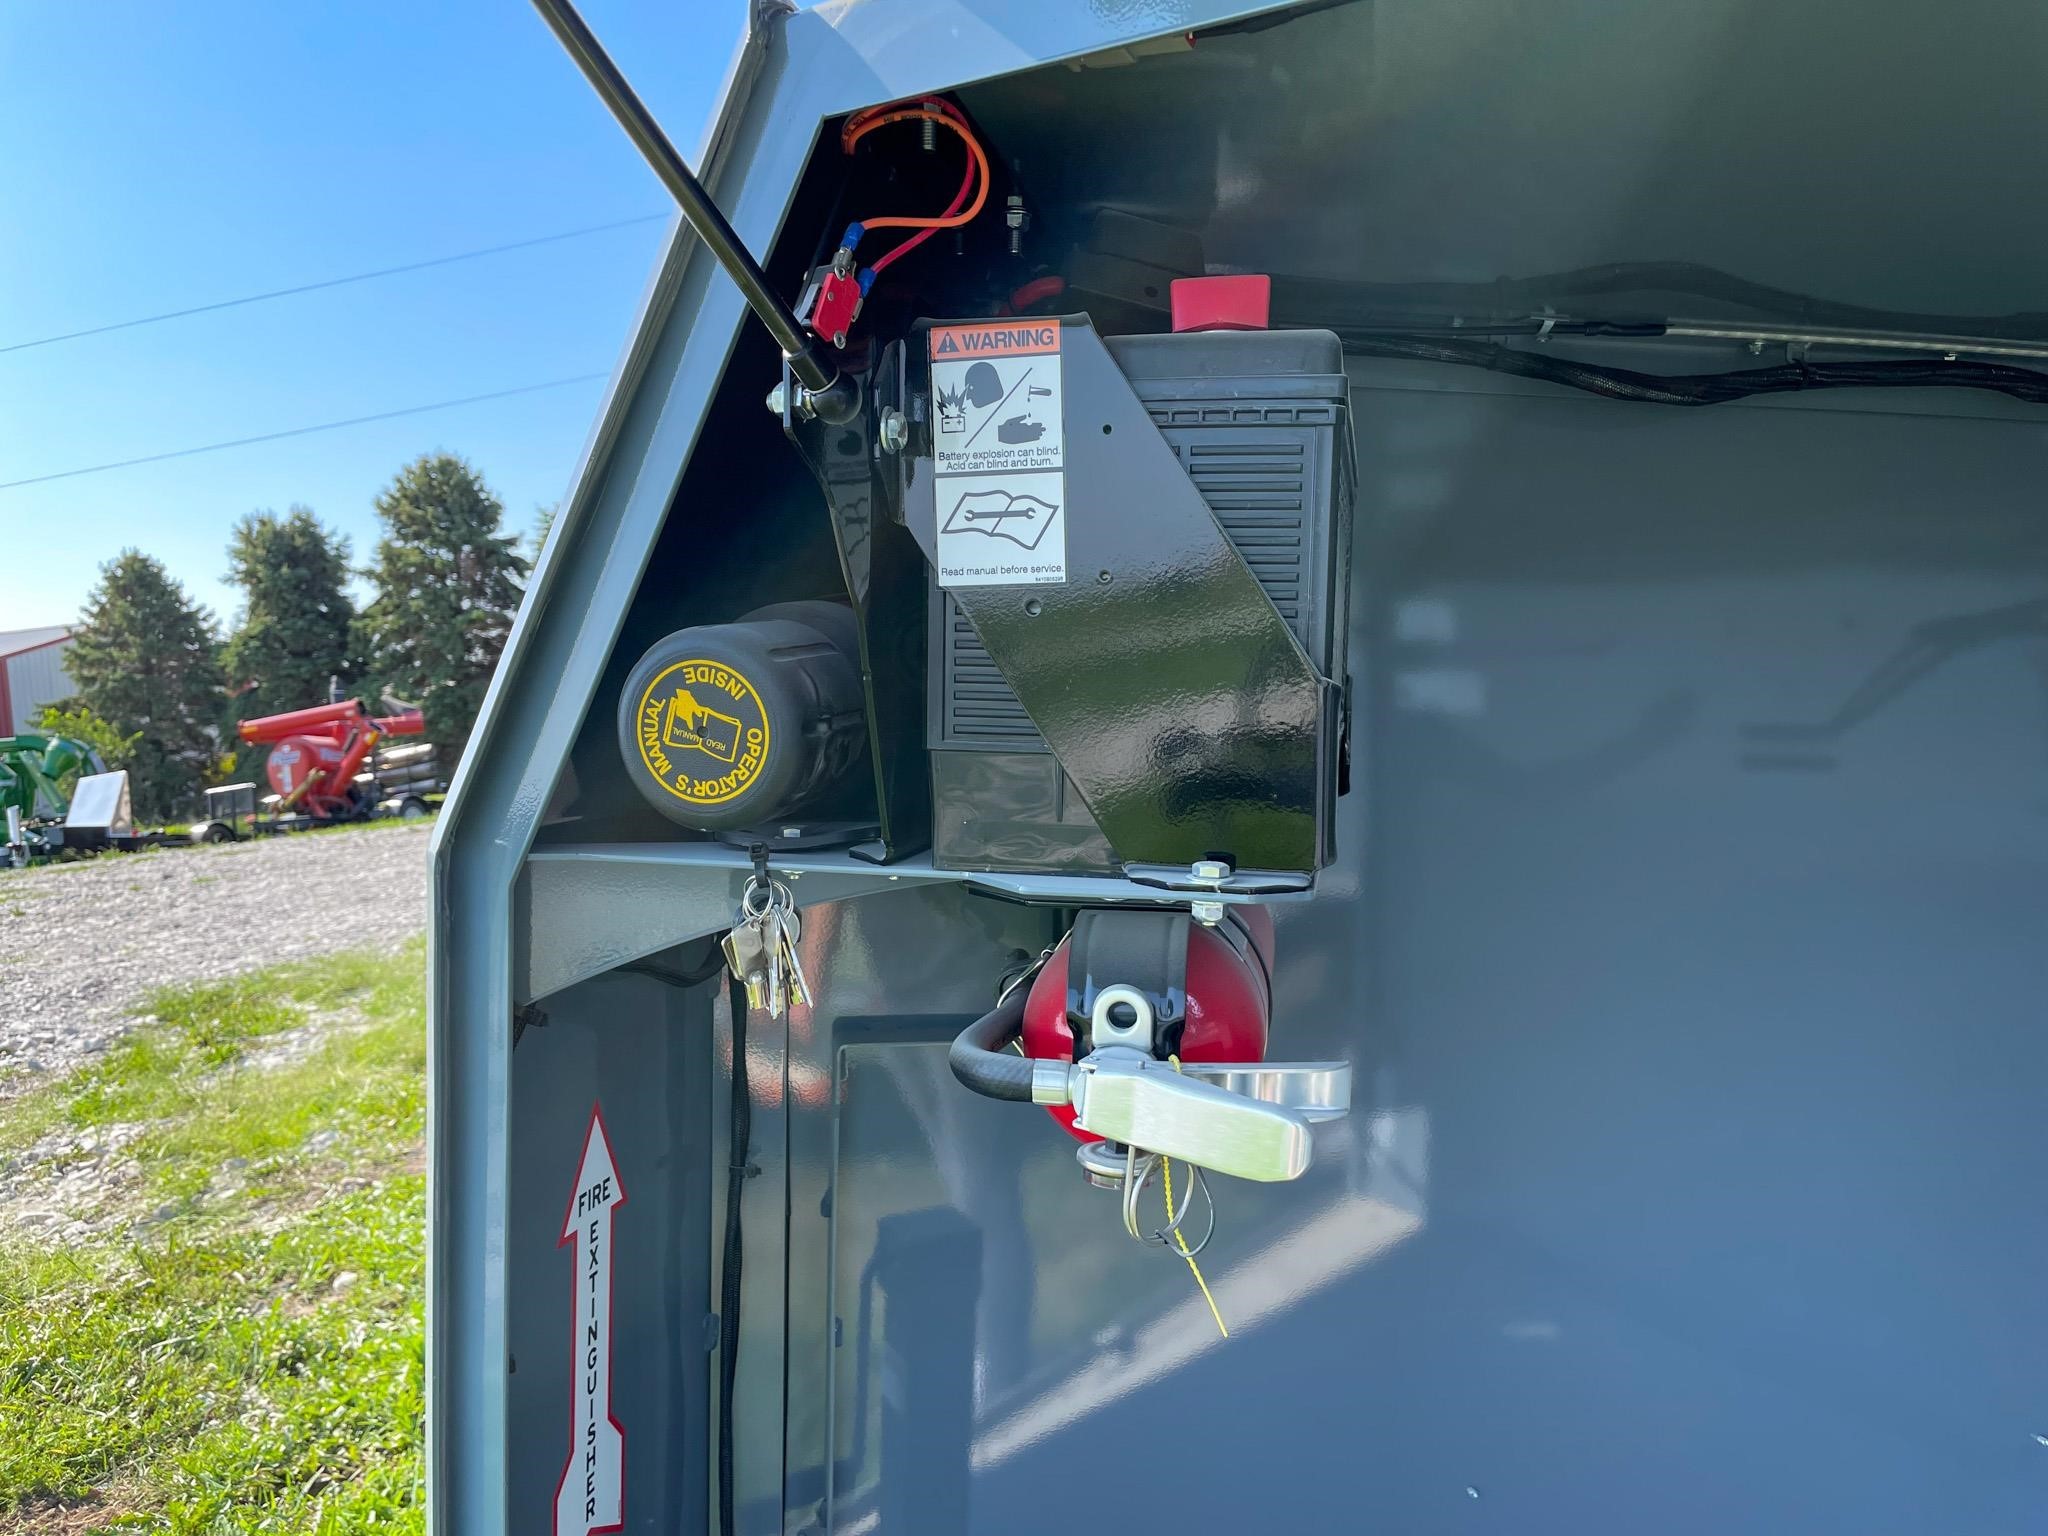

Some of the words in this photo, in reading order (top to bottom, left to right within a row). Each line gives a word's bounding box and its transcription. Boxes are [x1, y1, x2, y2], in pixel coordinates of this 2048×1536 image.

[962, 328, 1054, 351] WARNING
[938, 450, 970, 462] Battery
[972, 449, 1016, 461] explosion
[1017, 448, 1035, 458] can
[1036, 446, 1062, 456] blind.
[946, 460, 966, 471] Acid
[967, 461, 985, 470] can
[986, 459, 1009, 470] blind
[1010, 457, 1028, 468] and
[1030, 457, 1054, 467] burn.
[941, 567, 964, 577] Read
[966, 565, 998, 576] manual
[1000, 564, 1028, 575] before
[1030, 563, 1065, 574] service.
[683, 666, 747, 700] INSIDE
[643, 698, 673, 776] MANUAL
[706, 738, 726, 751] READ
[676, 728, 763, 797] OPERATOR'S
[578, 1176, 611, 1218] FIRE
[585, 1219, 599, 1523] EXTINGUISHER
